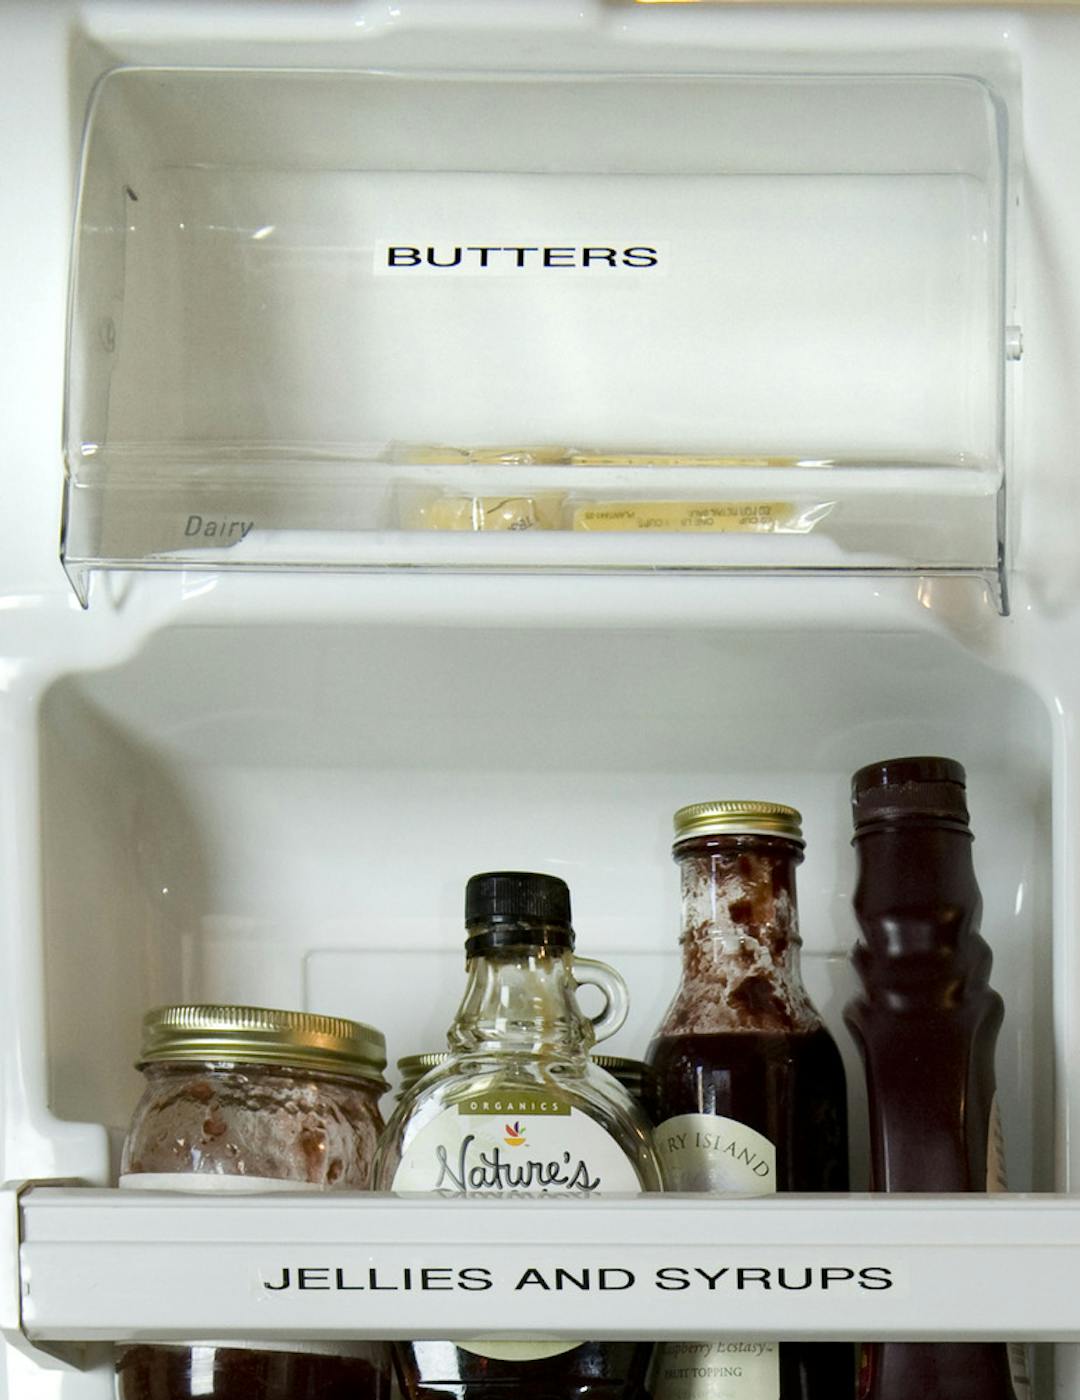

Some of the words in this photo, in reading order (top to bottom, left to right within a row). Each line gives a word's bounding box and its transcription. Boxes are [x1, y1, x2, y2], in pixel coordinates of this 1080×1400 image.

[387, 247, 659, 267] BUTTERS
[183, 514, 255, 543] Dairy
[469, 1101, 560, 1112] ORGANICS
[435, 1134, 601, 1192] Nature's
[695, 1132, 770, 1177] ISLAND
[263, 1268, 493, 1290] JELLIES
[515, 1268, 636, 1290] AND
[655, 1268, 894, 1290] SYRUPS
[692, 1367, 743, 1378] TOPPING
